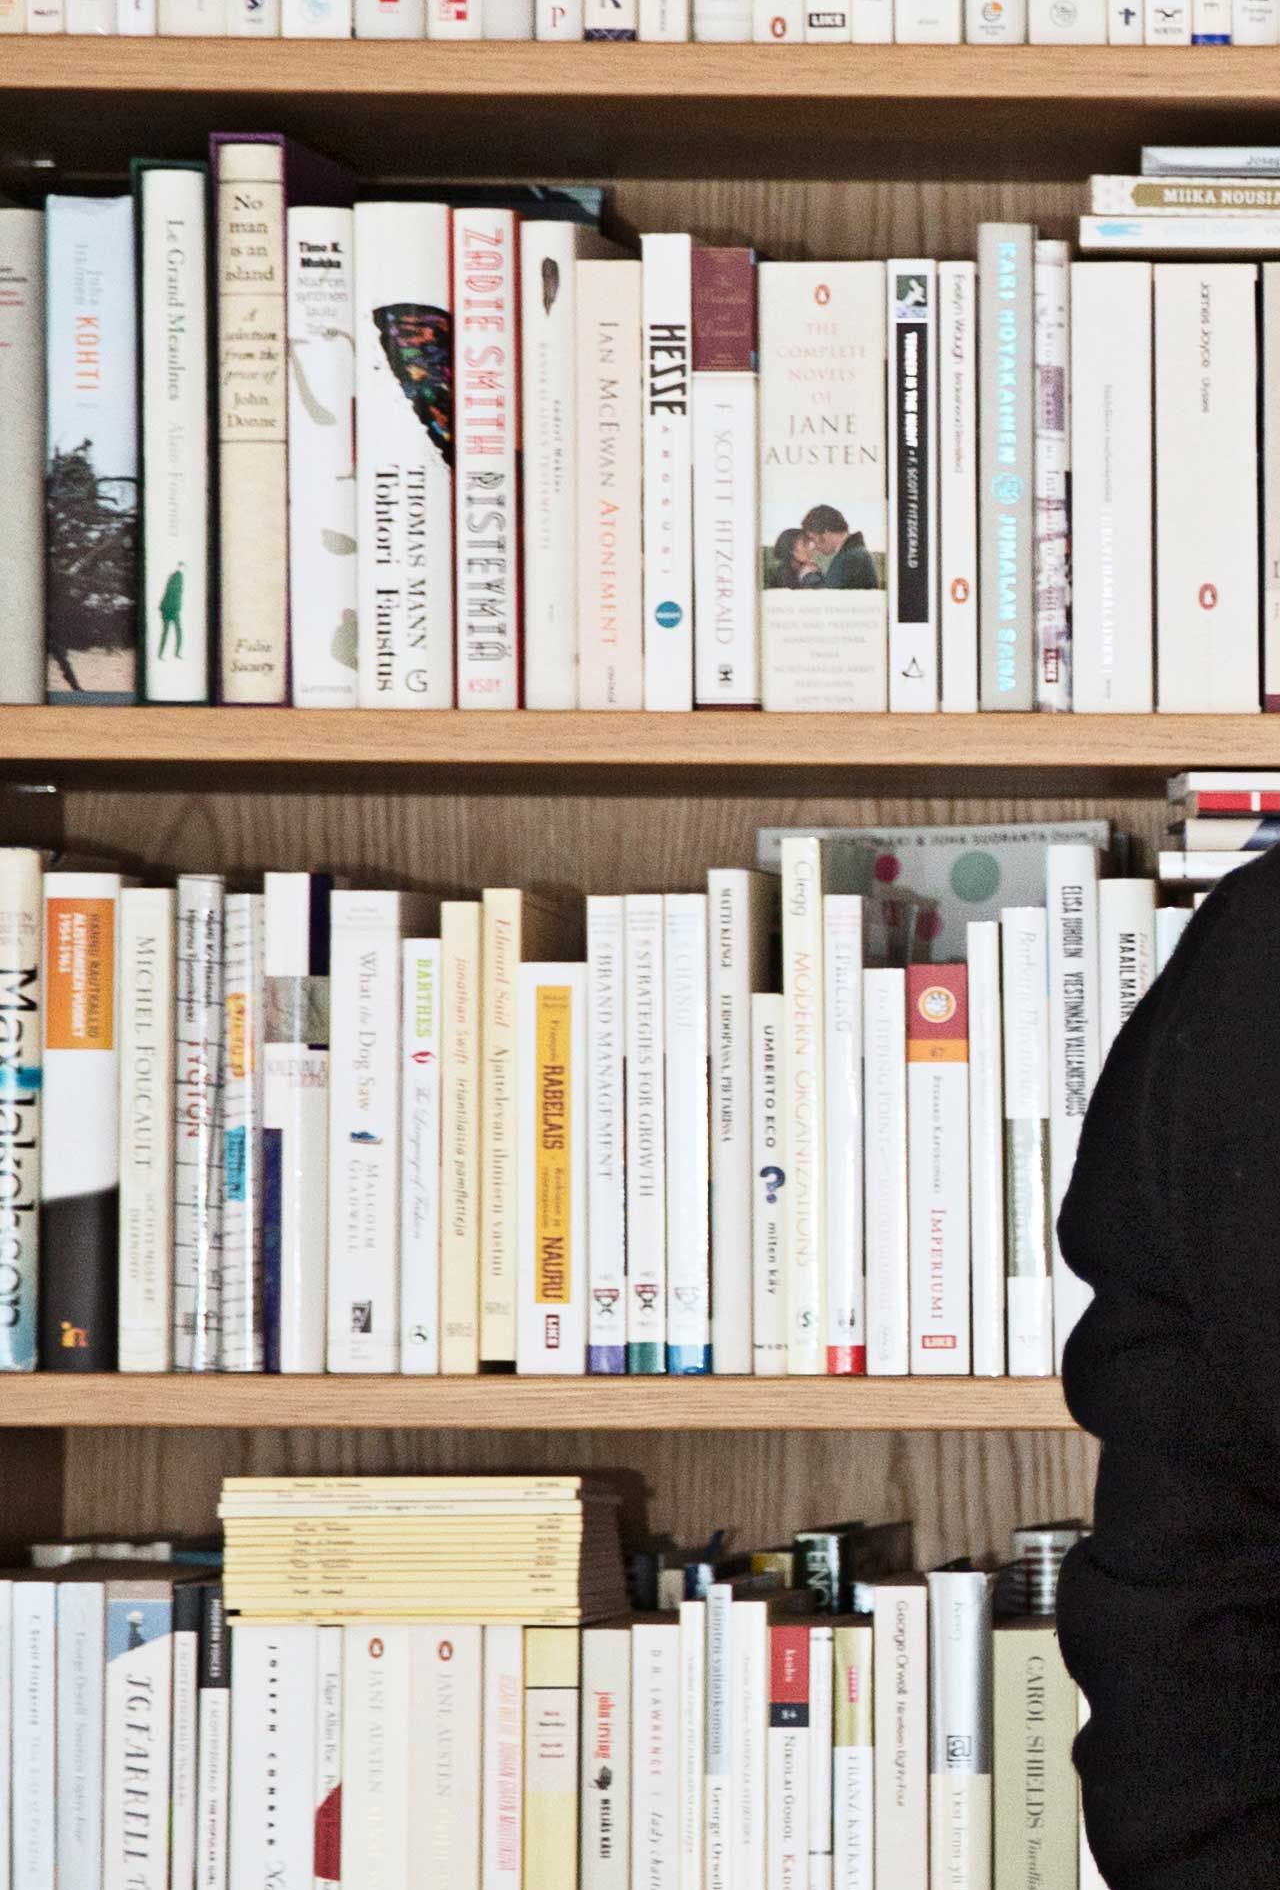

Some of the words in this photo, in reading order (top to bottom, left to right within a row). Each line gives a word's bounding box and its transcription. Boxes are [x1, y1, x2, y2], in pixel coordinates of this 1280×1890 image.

[465, 228, 503, 333] ZADIE
[466, 346, 504, 455] SMITH
[376, 465, 399, 565] Tohtori
[408, 466, 425, 568] THOMAS
[467, 470, 511, 662] RISTEYMIÄ
[376, 589, 397, 692] Faustus
[409, 578, 426, 649] MANN
[544, 1065, 563, 1149] RABELAIS
[543, 1236, 562, 1298] NAURU
